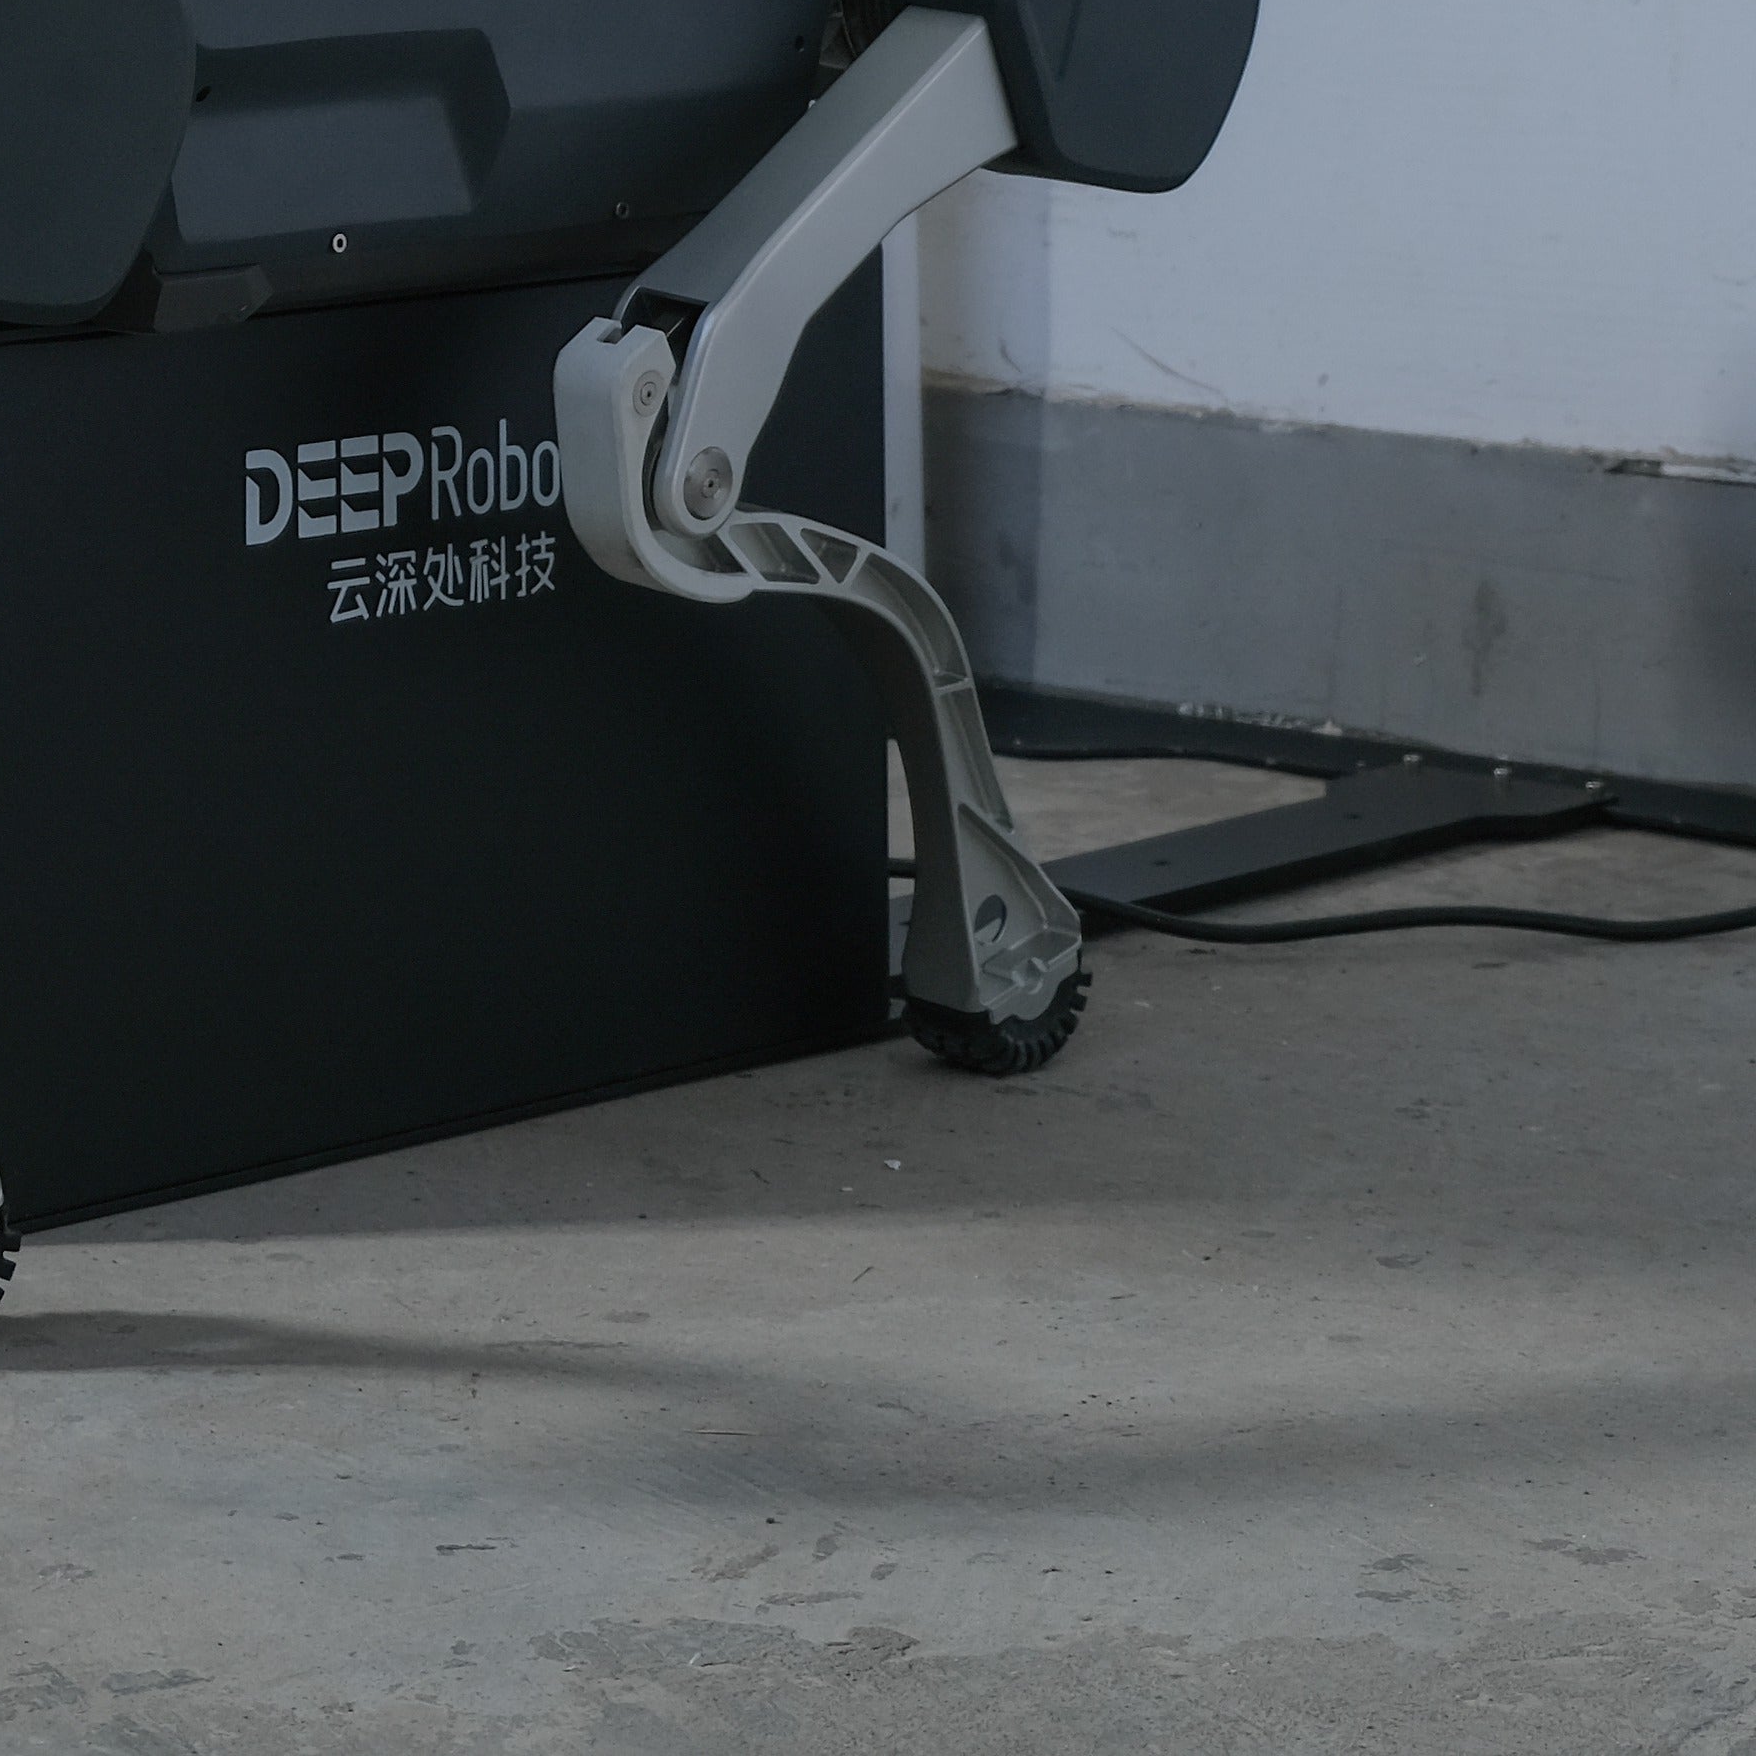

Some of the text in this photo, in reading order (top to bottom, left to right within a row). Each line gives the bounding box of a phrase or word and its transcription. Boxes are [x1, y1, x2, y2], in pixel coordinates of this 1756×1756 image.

[327, 530, 556, 623] 云深处科技
